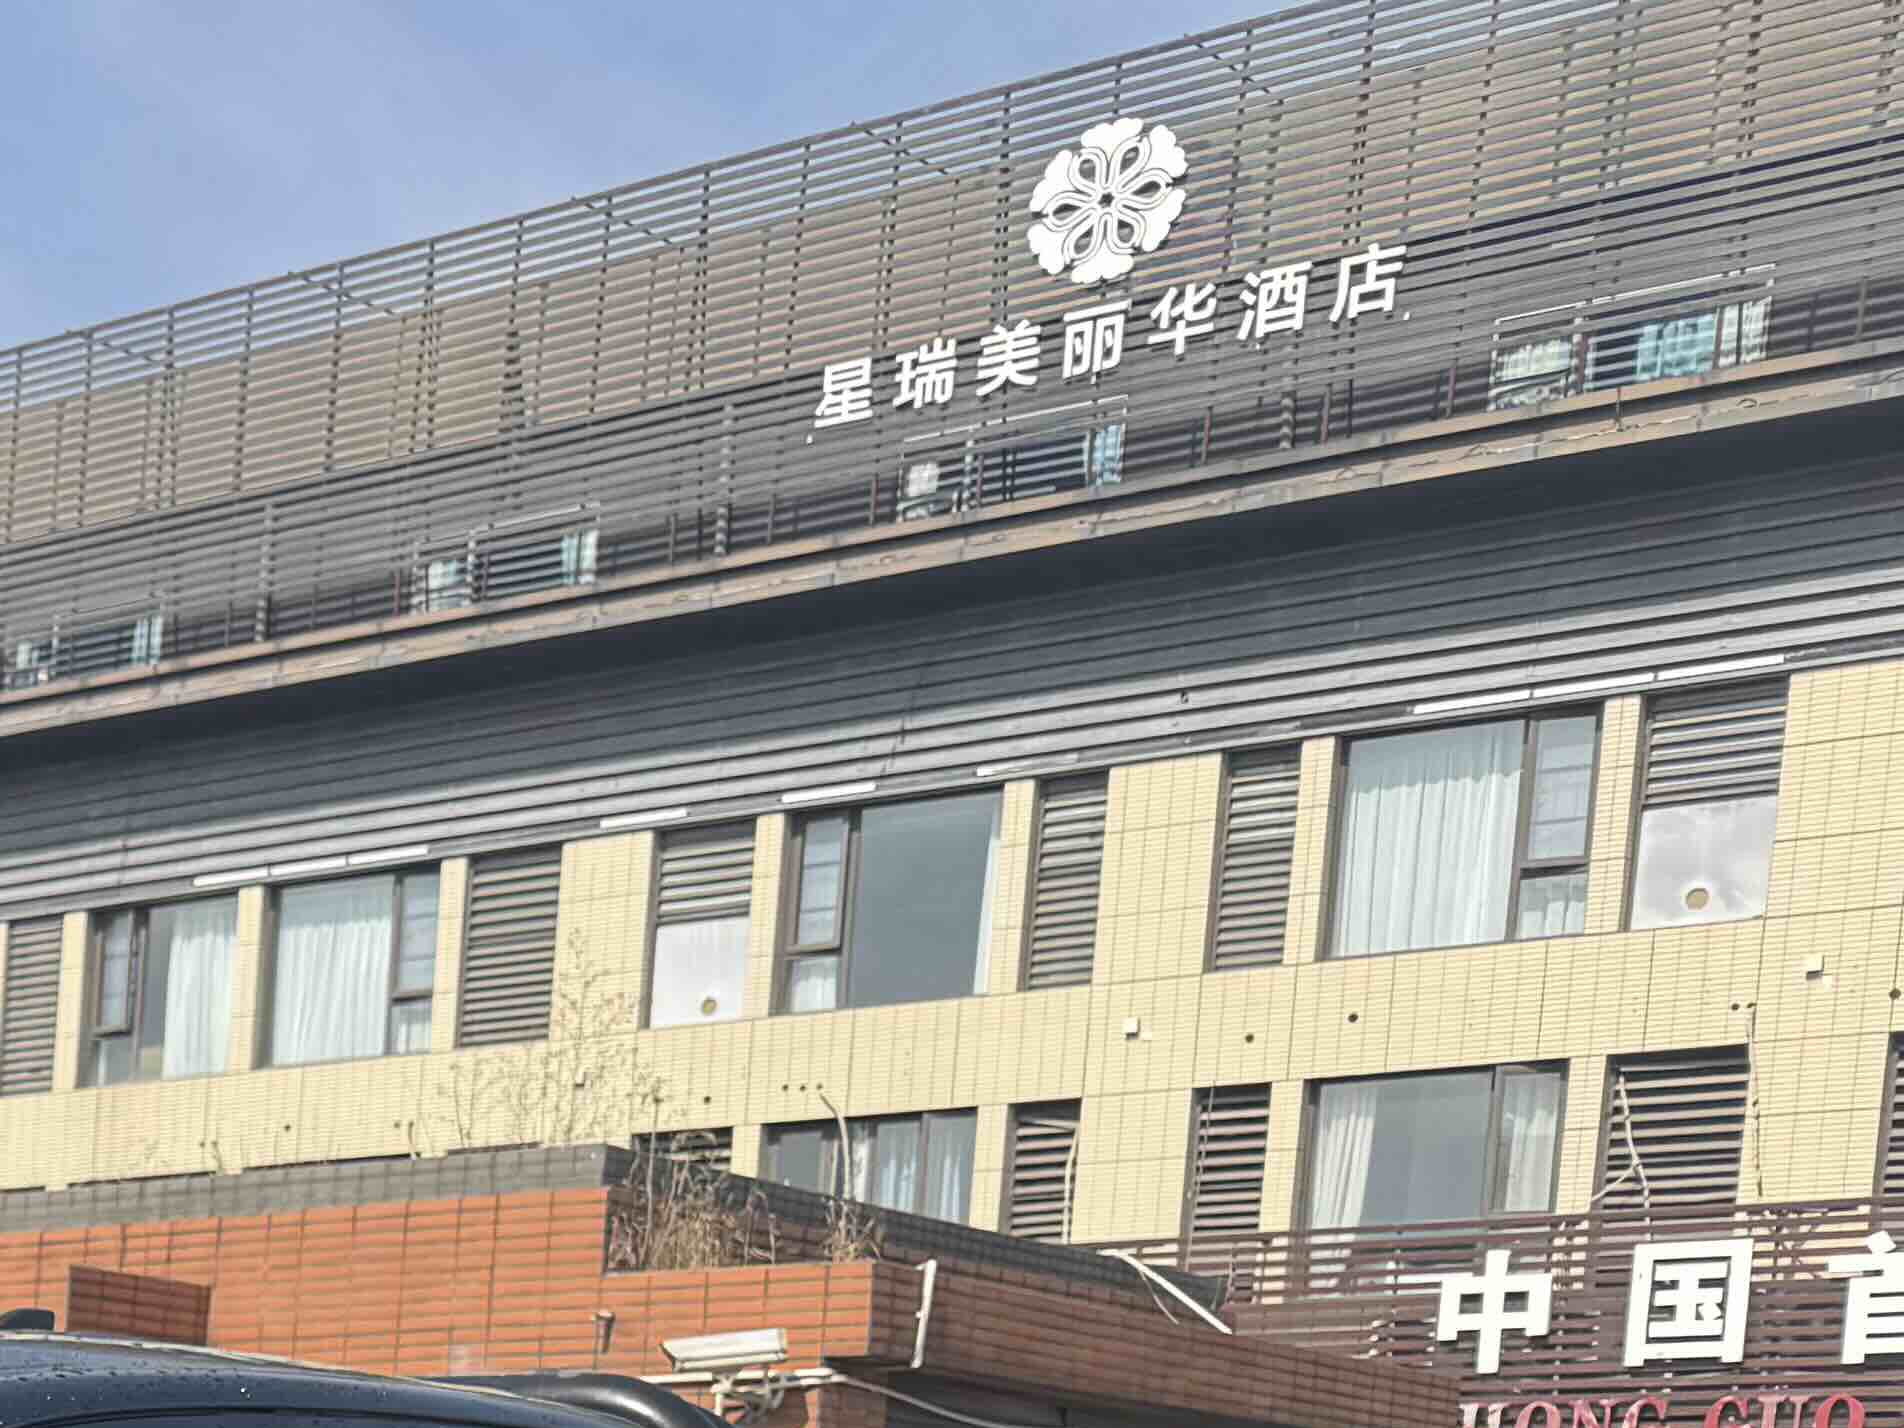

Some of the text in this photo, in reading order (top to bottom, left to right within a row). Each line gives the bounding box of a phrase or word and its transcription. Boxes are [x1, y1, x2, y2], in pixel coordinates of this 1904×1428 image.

[814, 243, 1407, 430] 星瑞美丽华酒店
